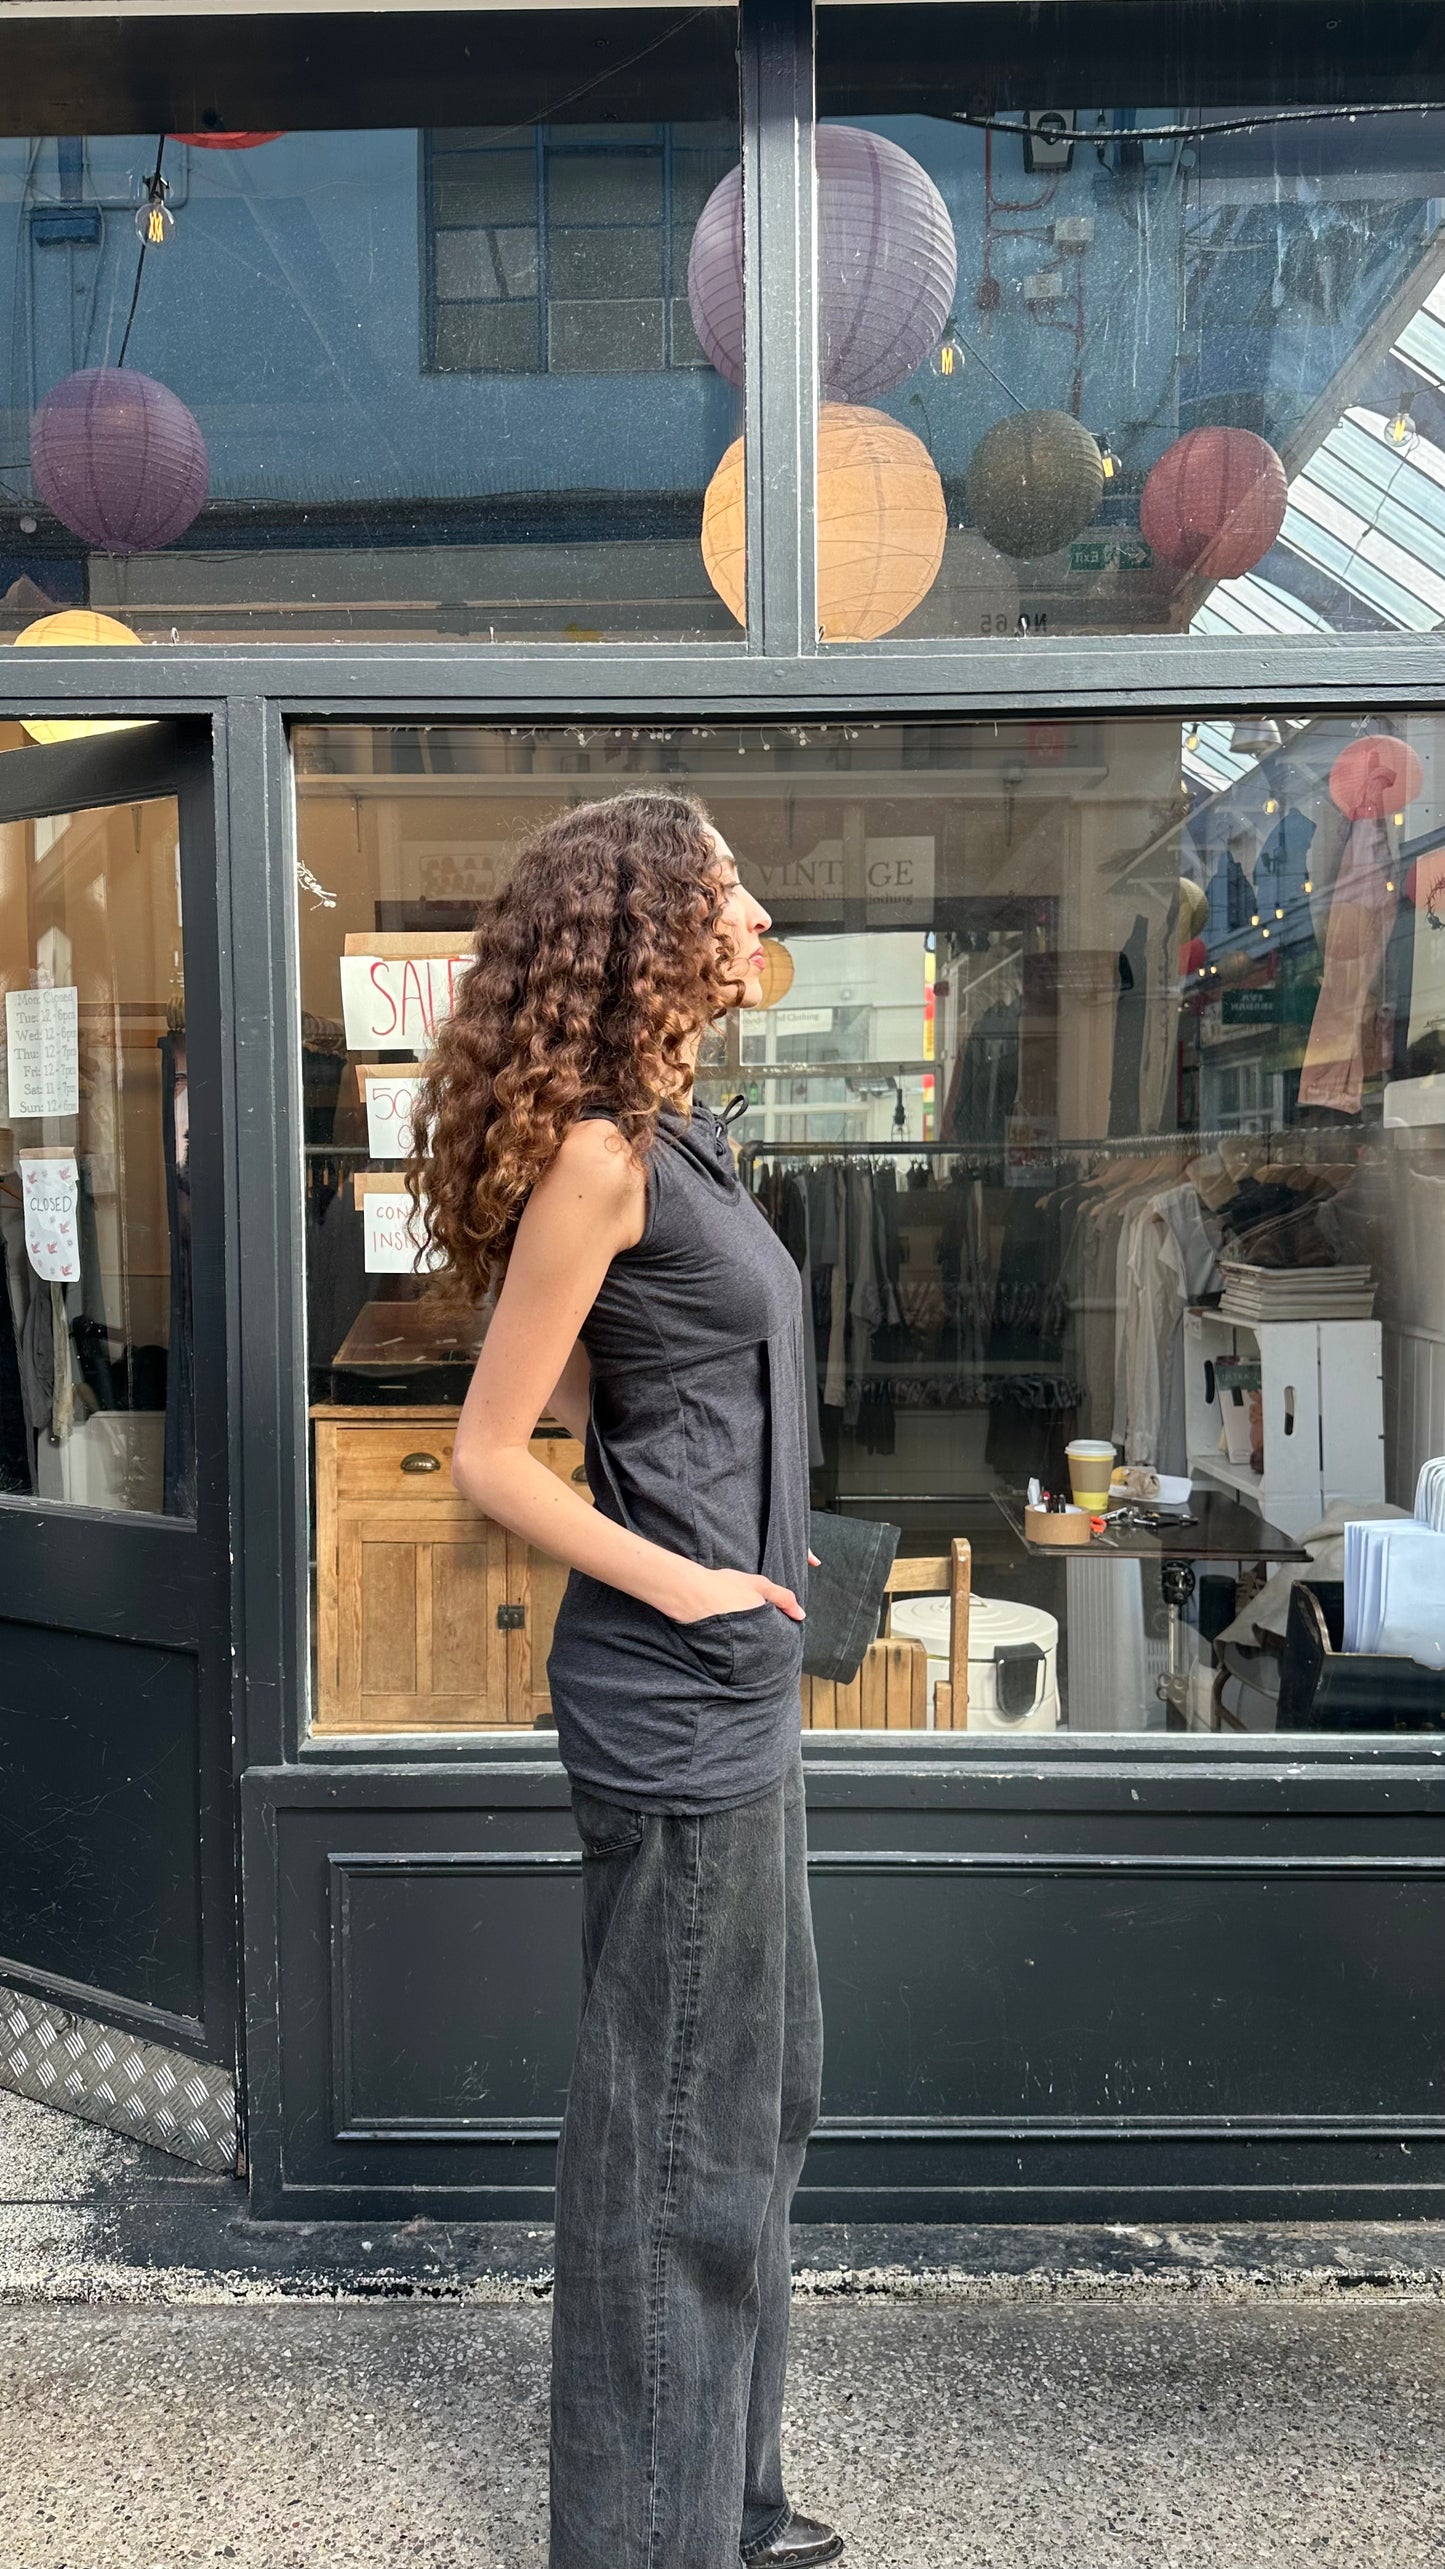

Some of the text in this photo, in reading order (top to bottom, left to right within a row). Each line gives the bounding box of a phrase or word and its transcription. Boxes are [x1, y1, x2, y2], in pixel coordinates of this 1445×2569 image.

[759, 860, 914, 888] VINTGE
[373, 1087, 430, 1120] 50
[30, 1195, 72, 1212] CLOSED
